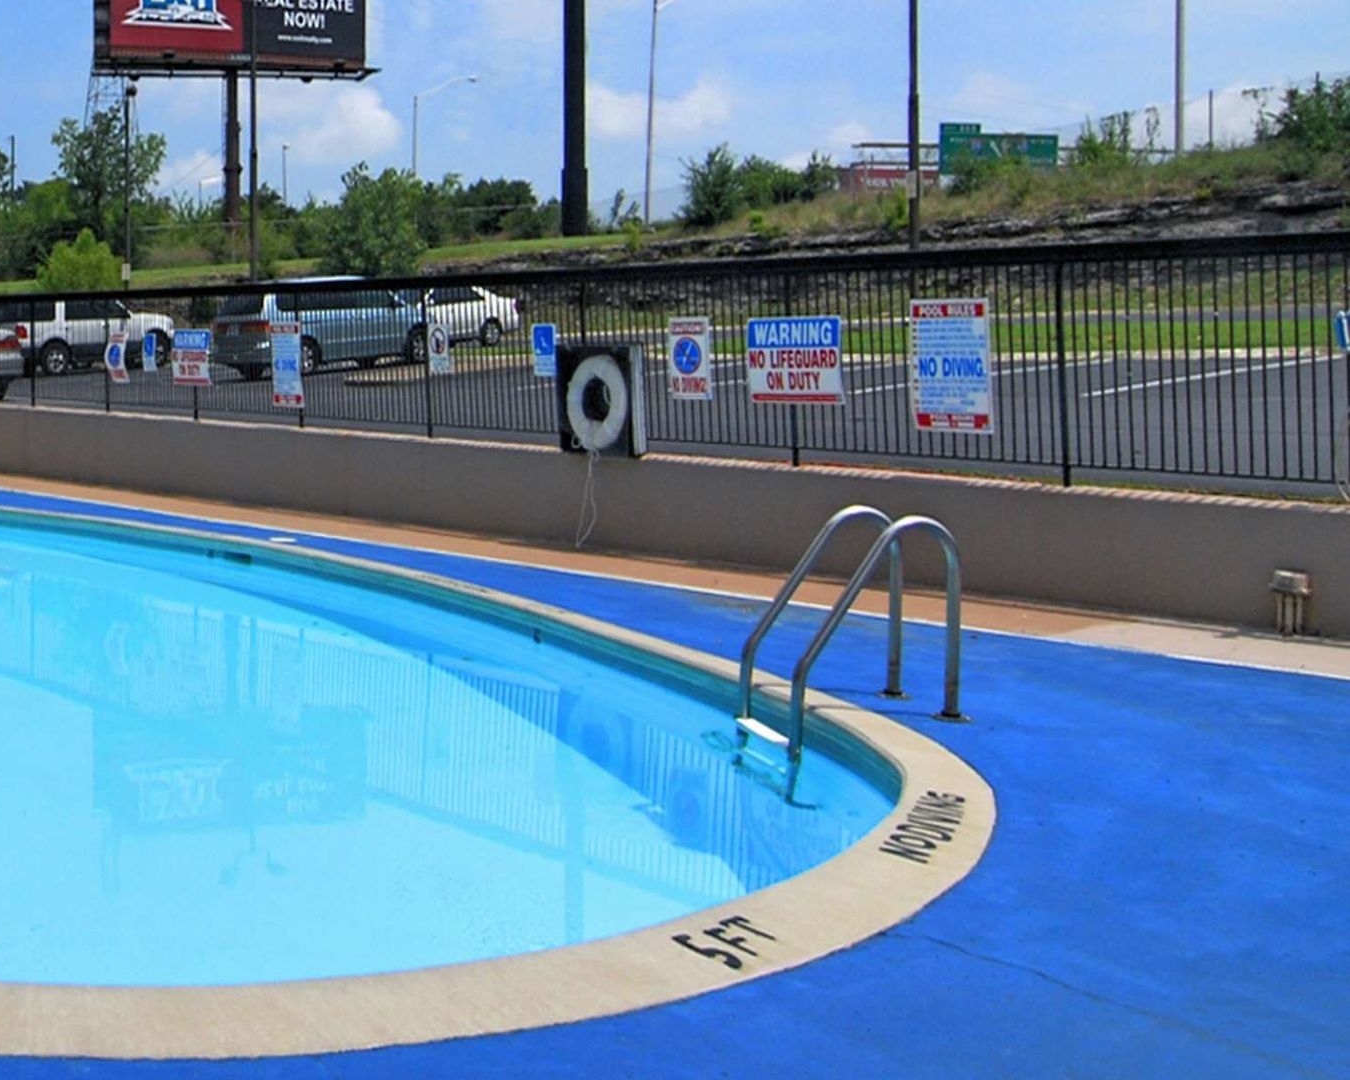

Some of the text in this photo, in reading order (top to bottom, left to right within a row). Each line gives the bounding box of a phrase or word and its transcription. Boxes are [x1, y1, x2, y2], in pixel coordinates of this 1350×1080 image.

[283, 10, 326, 29] NOW!
[920, 304, 940, 318] POOL
[754, 321, 832, 346] WARNING
[749, 349, 837, 369] NO LIFEGUARD
[919, 358, 938, 377] NO
[766, 371, 821, 390] ON DUTY
[671, 915, 777, 970] 5 FT
